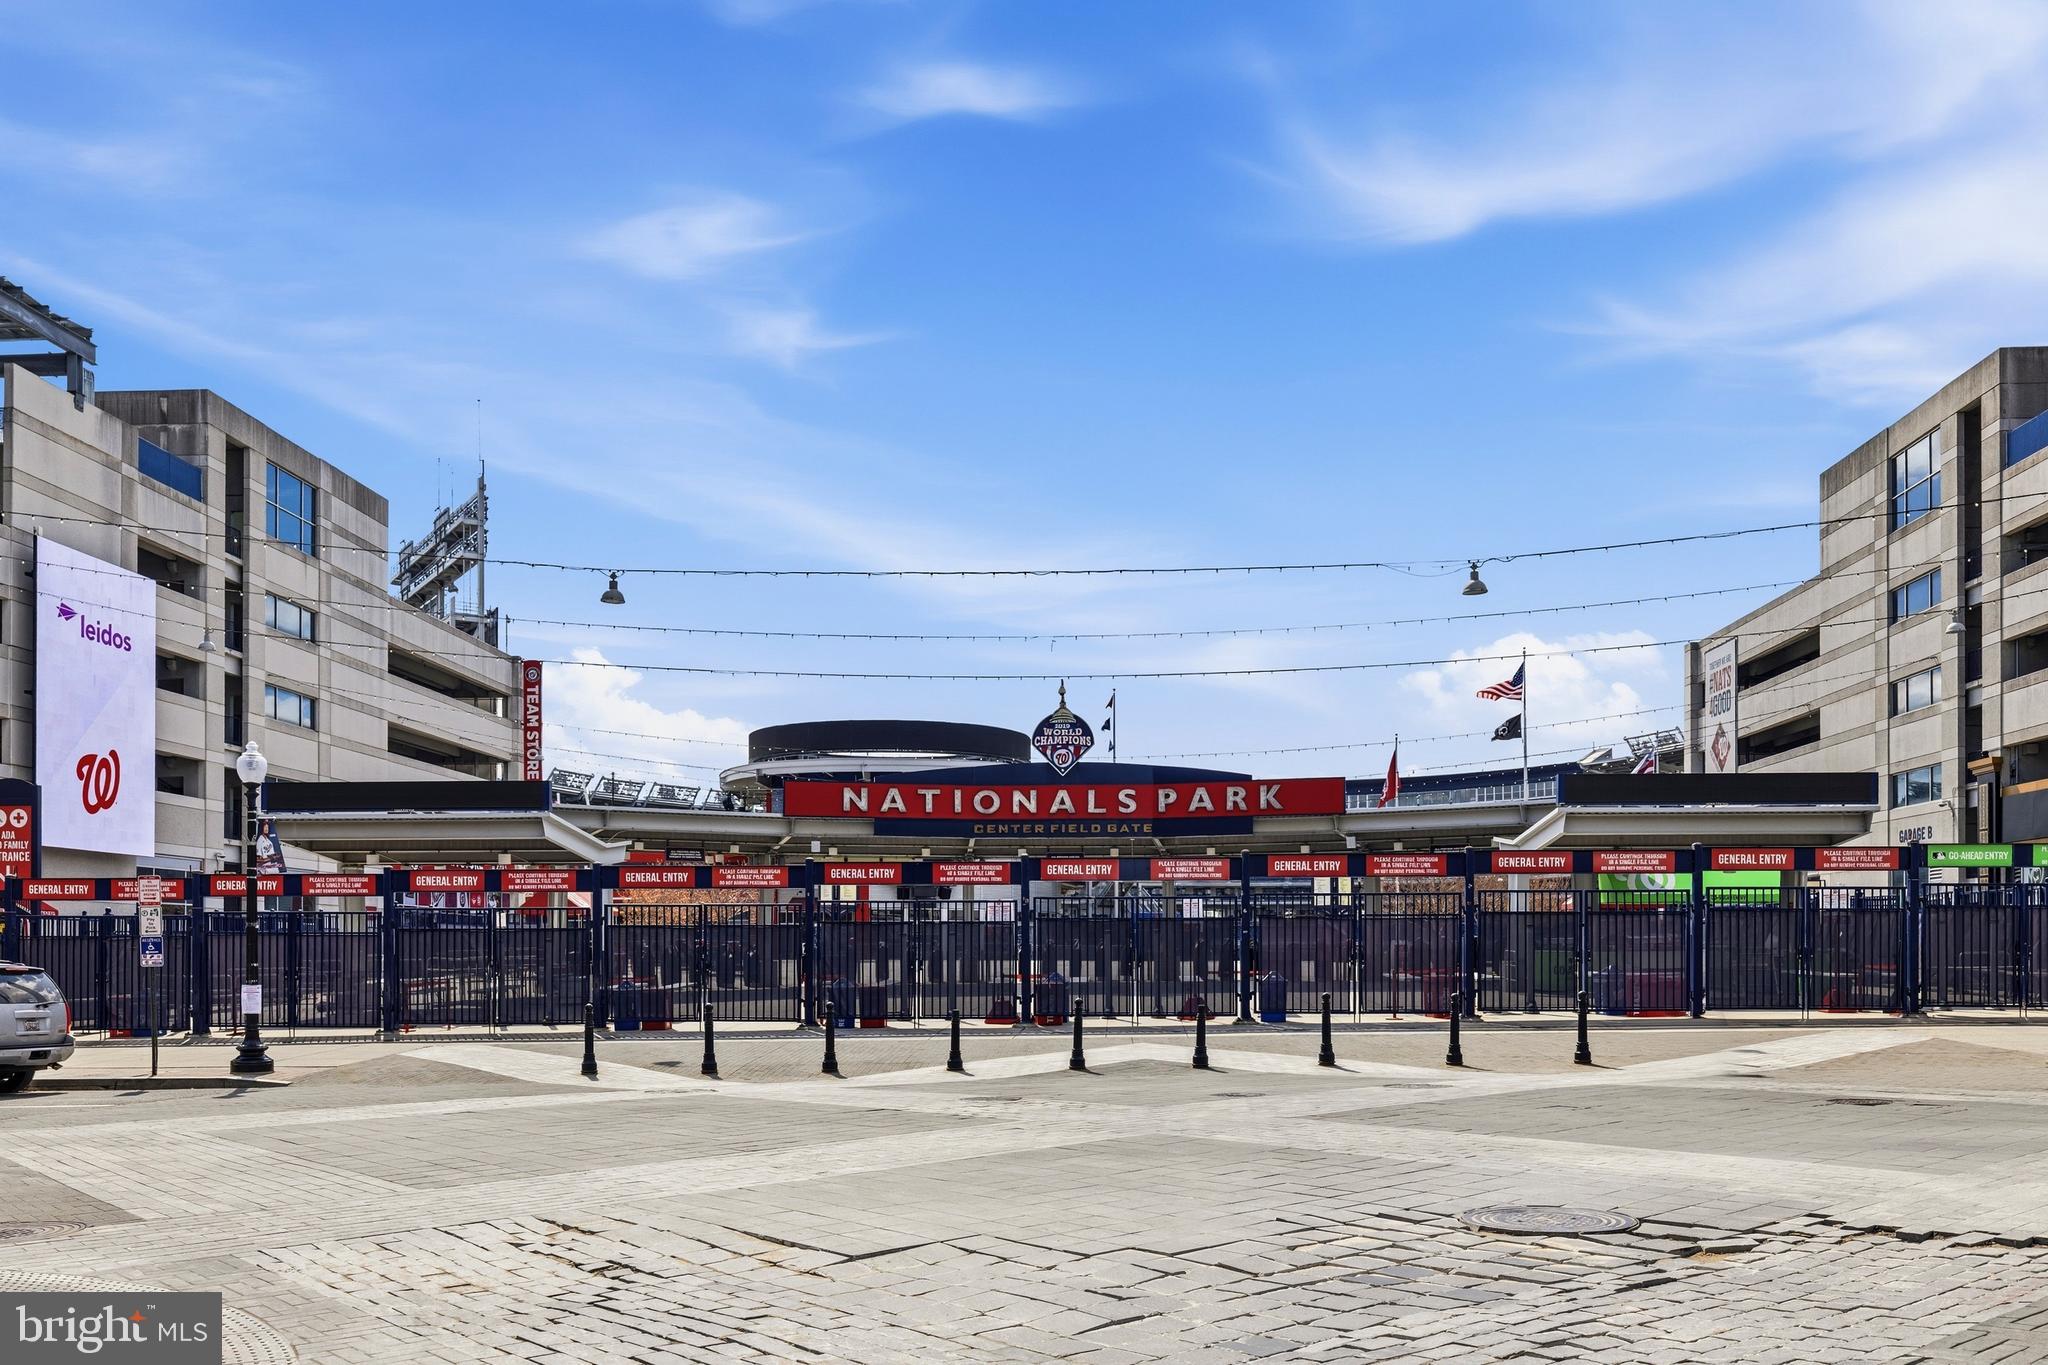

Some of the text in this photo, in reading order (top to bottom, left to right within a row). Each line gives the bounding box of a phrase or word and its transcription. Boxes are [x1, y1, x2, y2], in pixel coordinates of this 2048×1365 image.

[80, 614, 132, 652] leidos
[527, 685, 540, 780] TEAM STORE
[1043, 727, 1082, 736] WORLD
[1034, 736, 1091, 747] CHAMPIONS
[76, 750, 120, 815] W
[842, 784, 1285, 815] NATIONALS PARK
[974, 823, 1153, 834] CENTER FIELD GATE
[1927, 826, 1933, 840] B
[1, 831, 16, 840] ADA
[3, 841, 29, 850] FAMILY
[1718, 854, 1787, 865] GENERAL ENTRY
[1949, 851, 2009, 860] GO-AHEAD ENTRY
[1274, 860, 1341, 871] GENERAL ENTRY
[1498, 857, 1566, 868] GENERAL ENTRY
[830, 868, 895, 879] GENERAL ENTRY
[1047, 864, 1112, 875] GENERAL ENTRY
[416, 876, 478, 887] GENERAL ENTRY
[625, 872, 689, 883] GENERAL ENTRY
[28, 884, 89, 895] GENERAL ENTRY
[216, 880, 277, 891] GENERA NTRY
